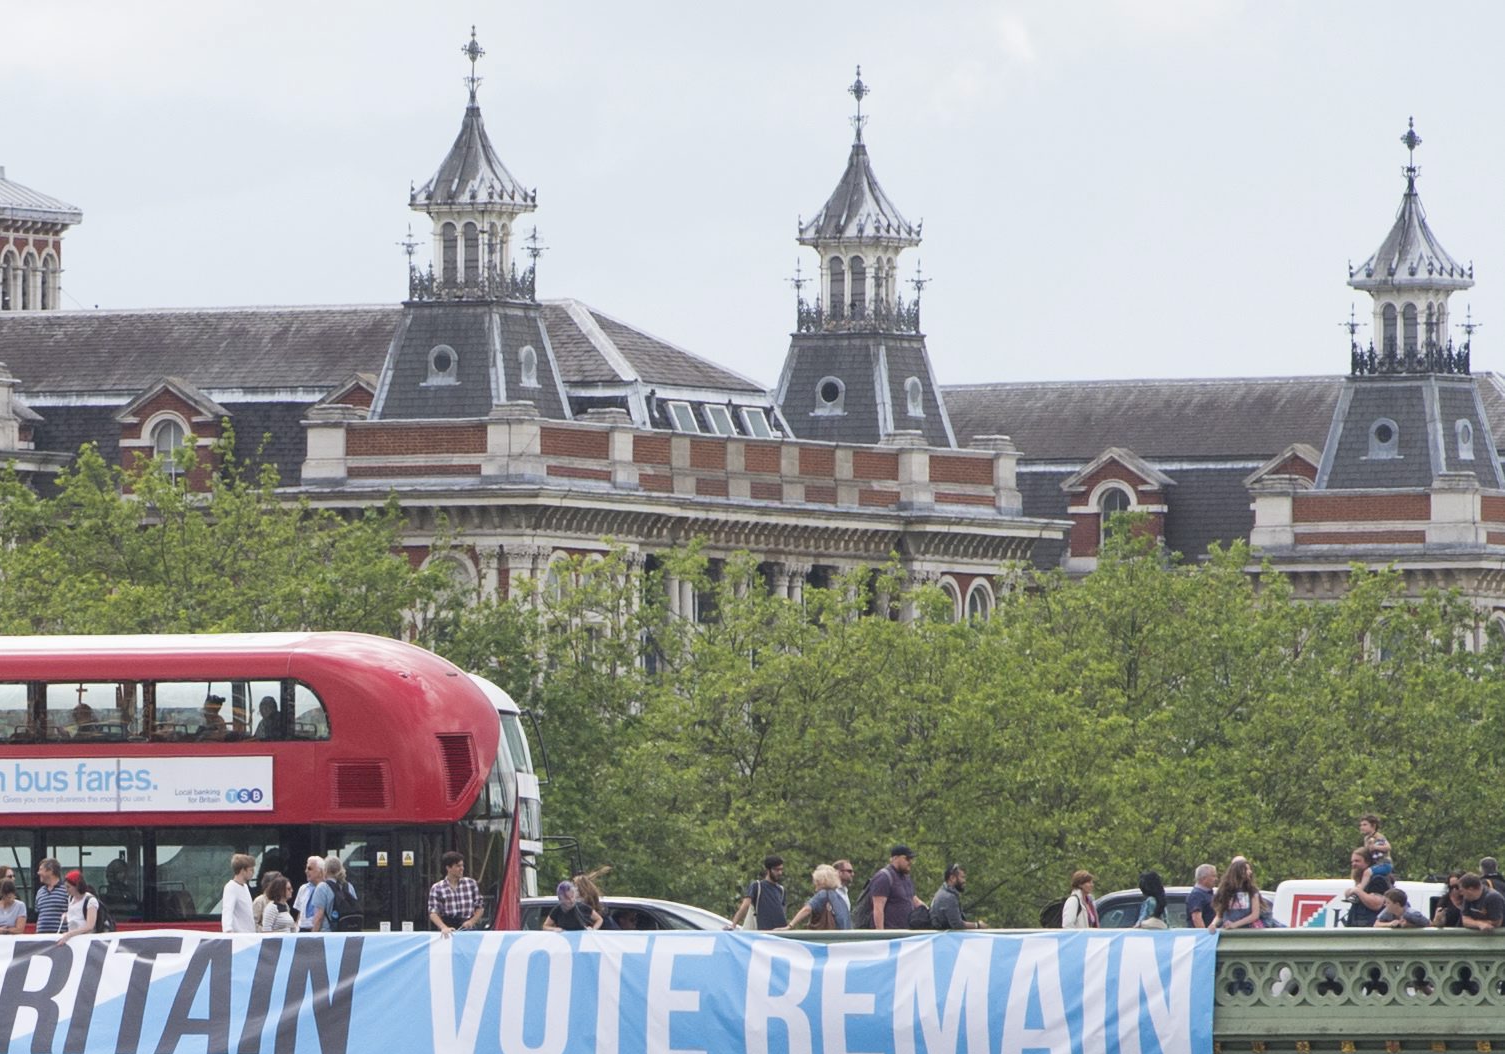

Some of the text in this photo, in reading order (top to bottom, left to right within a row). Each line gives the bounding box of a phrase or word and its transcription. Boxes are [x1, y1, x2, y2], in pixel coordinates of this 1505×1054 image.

[15, 763, 68, 792] bus
[75, 763, 158, 791] fares.
[174, 788, 220, 799] Local banking
[227, 789, 261, 803] TSB
[188, 796, 221, 804] for Britain
